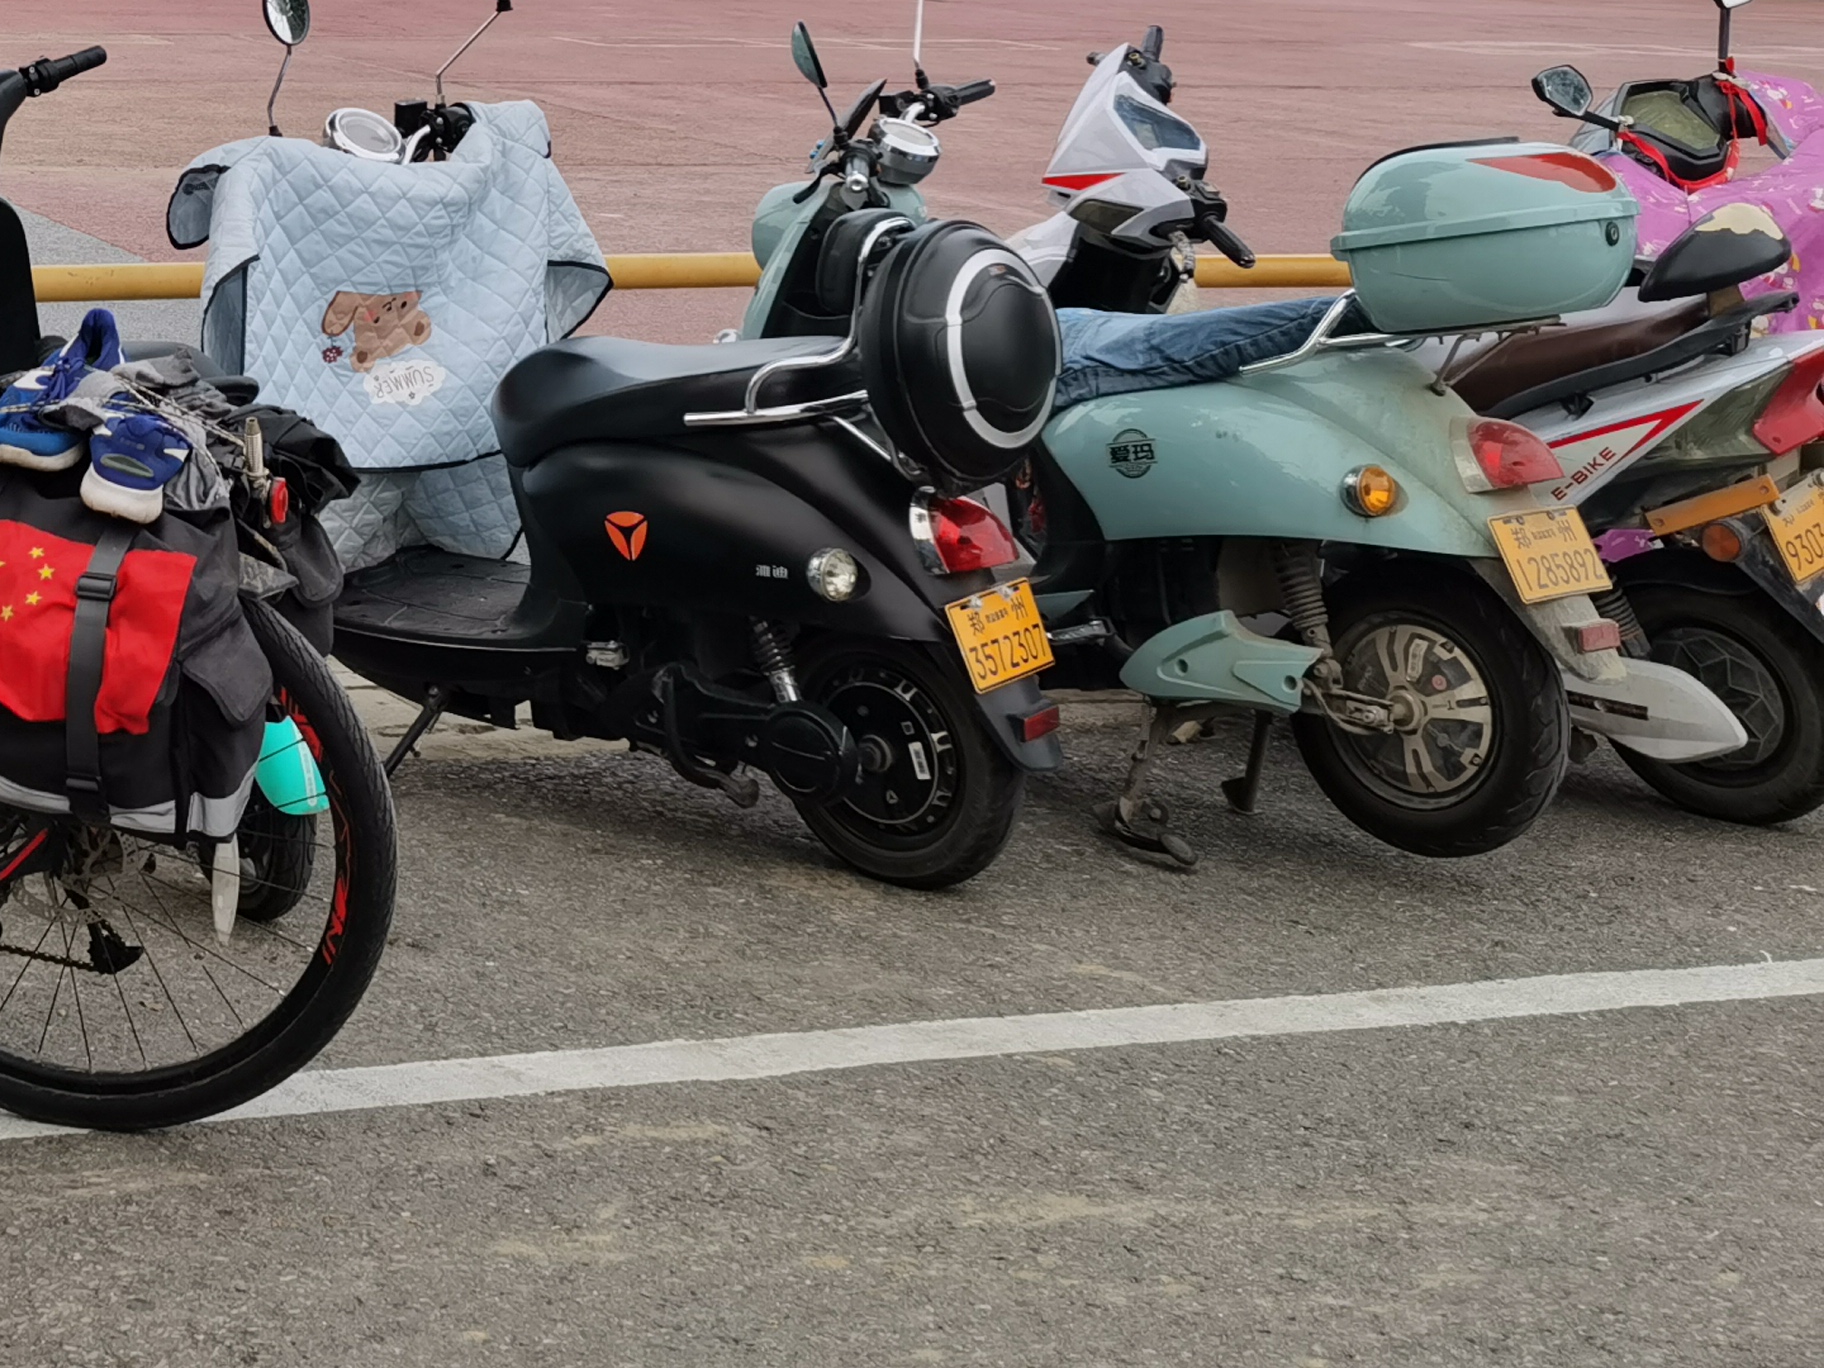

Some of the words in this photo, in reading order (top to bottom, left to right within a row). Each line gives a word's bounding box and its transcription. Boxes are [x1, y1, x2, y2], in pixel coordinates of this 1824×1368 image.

[373, 365, 435, 399] SUMMER
[1108, 443, 1155, 463] 爱玛
[1550, 446, 1617, 501] E-BIKE
[1511, 527, 1532, 549] 郑
[1557, 519, 1577, 542] 州
[1516, 548, 1605, 591] 1285892
[967, 611, 985, 636] 郑
[1011, 595, 1028, 620] 州
[969, 623, 1046, 680] 3572307
